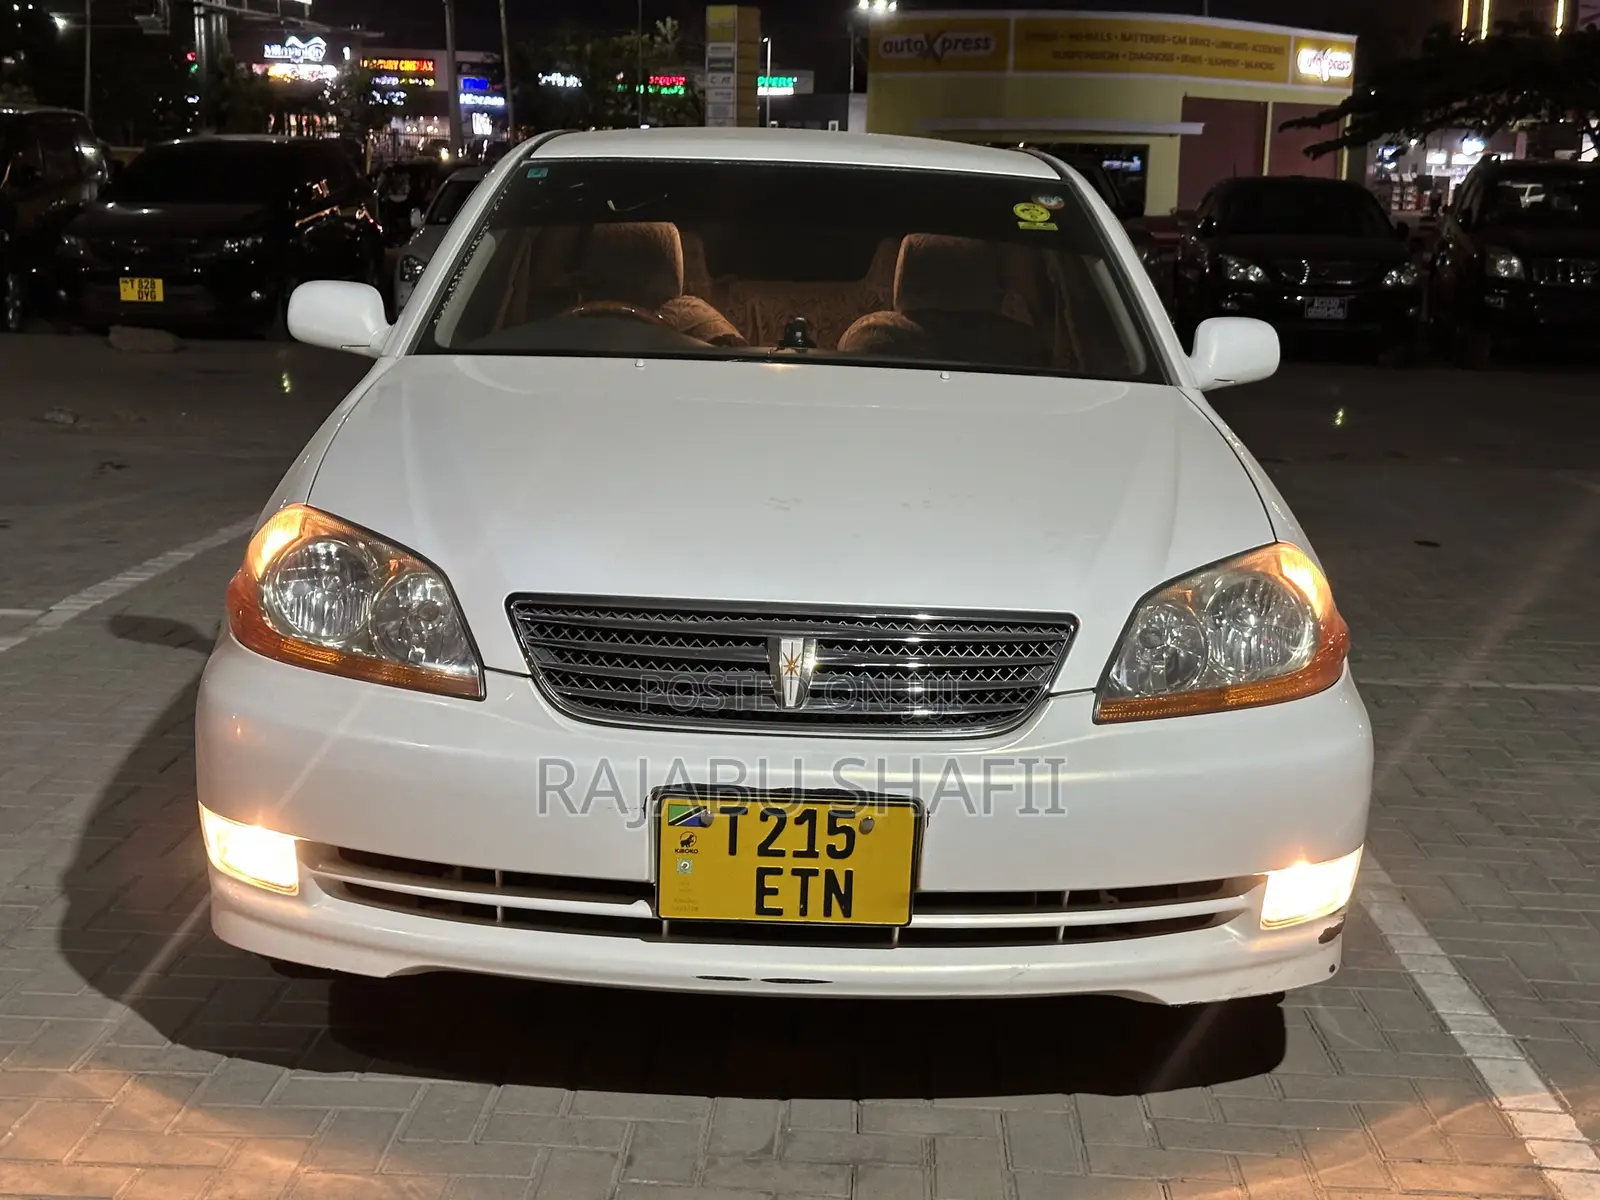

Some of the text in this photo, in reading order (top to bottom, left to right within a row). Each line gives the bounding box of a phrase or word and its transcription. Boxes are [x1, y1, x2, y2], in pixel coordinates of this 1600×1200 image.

[882, 30, 991, 63] autoXpress
[720, 806, 857, 860] T 215
[755, 866, 854, 918] ETN
